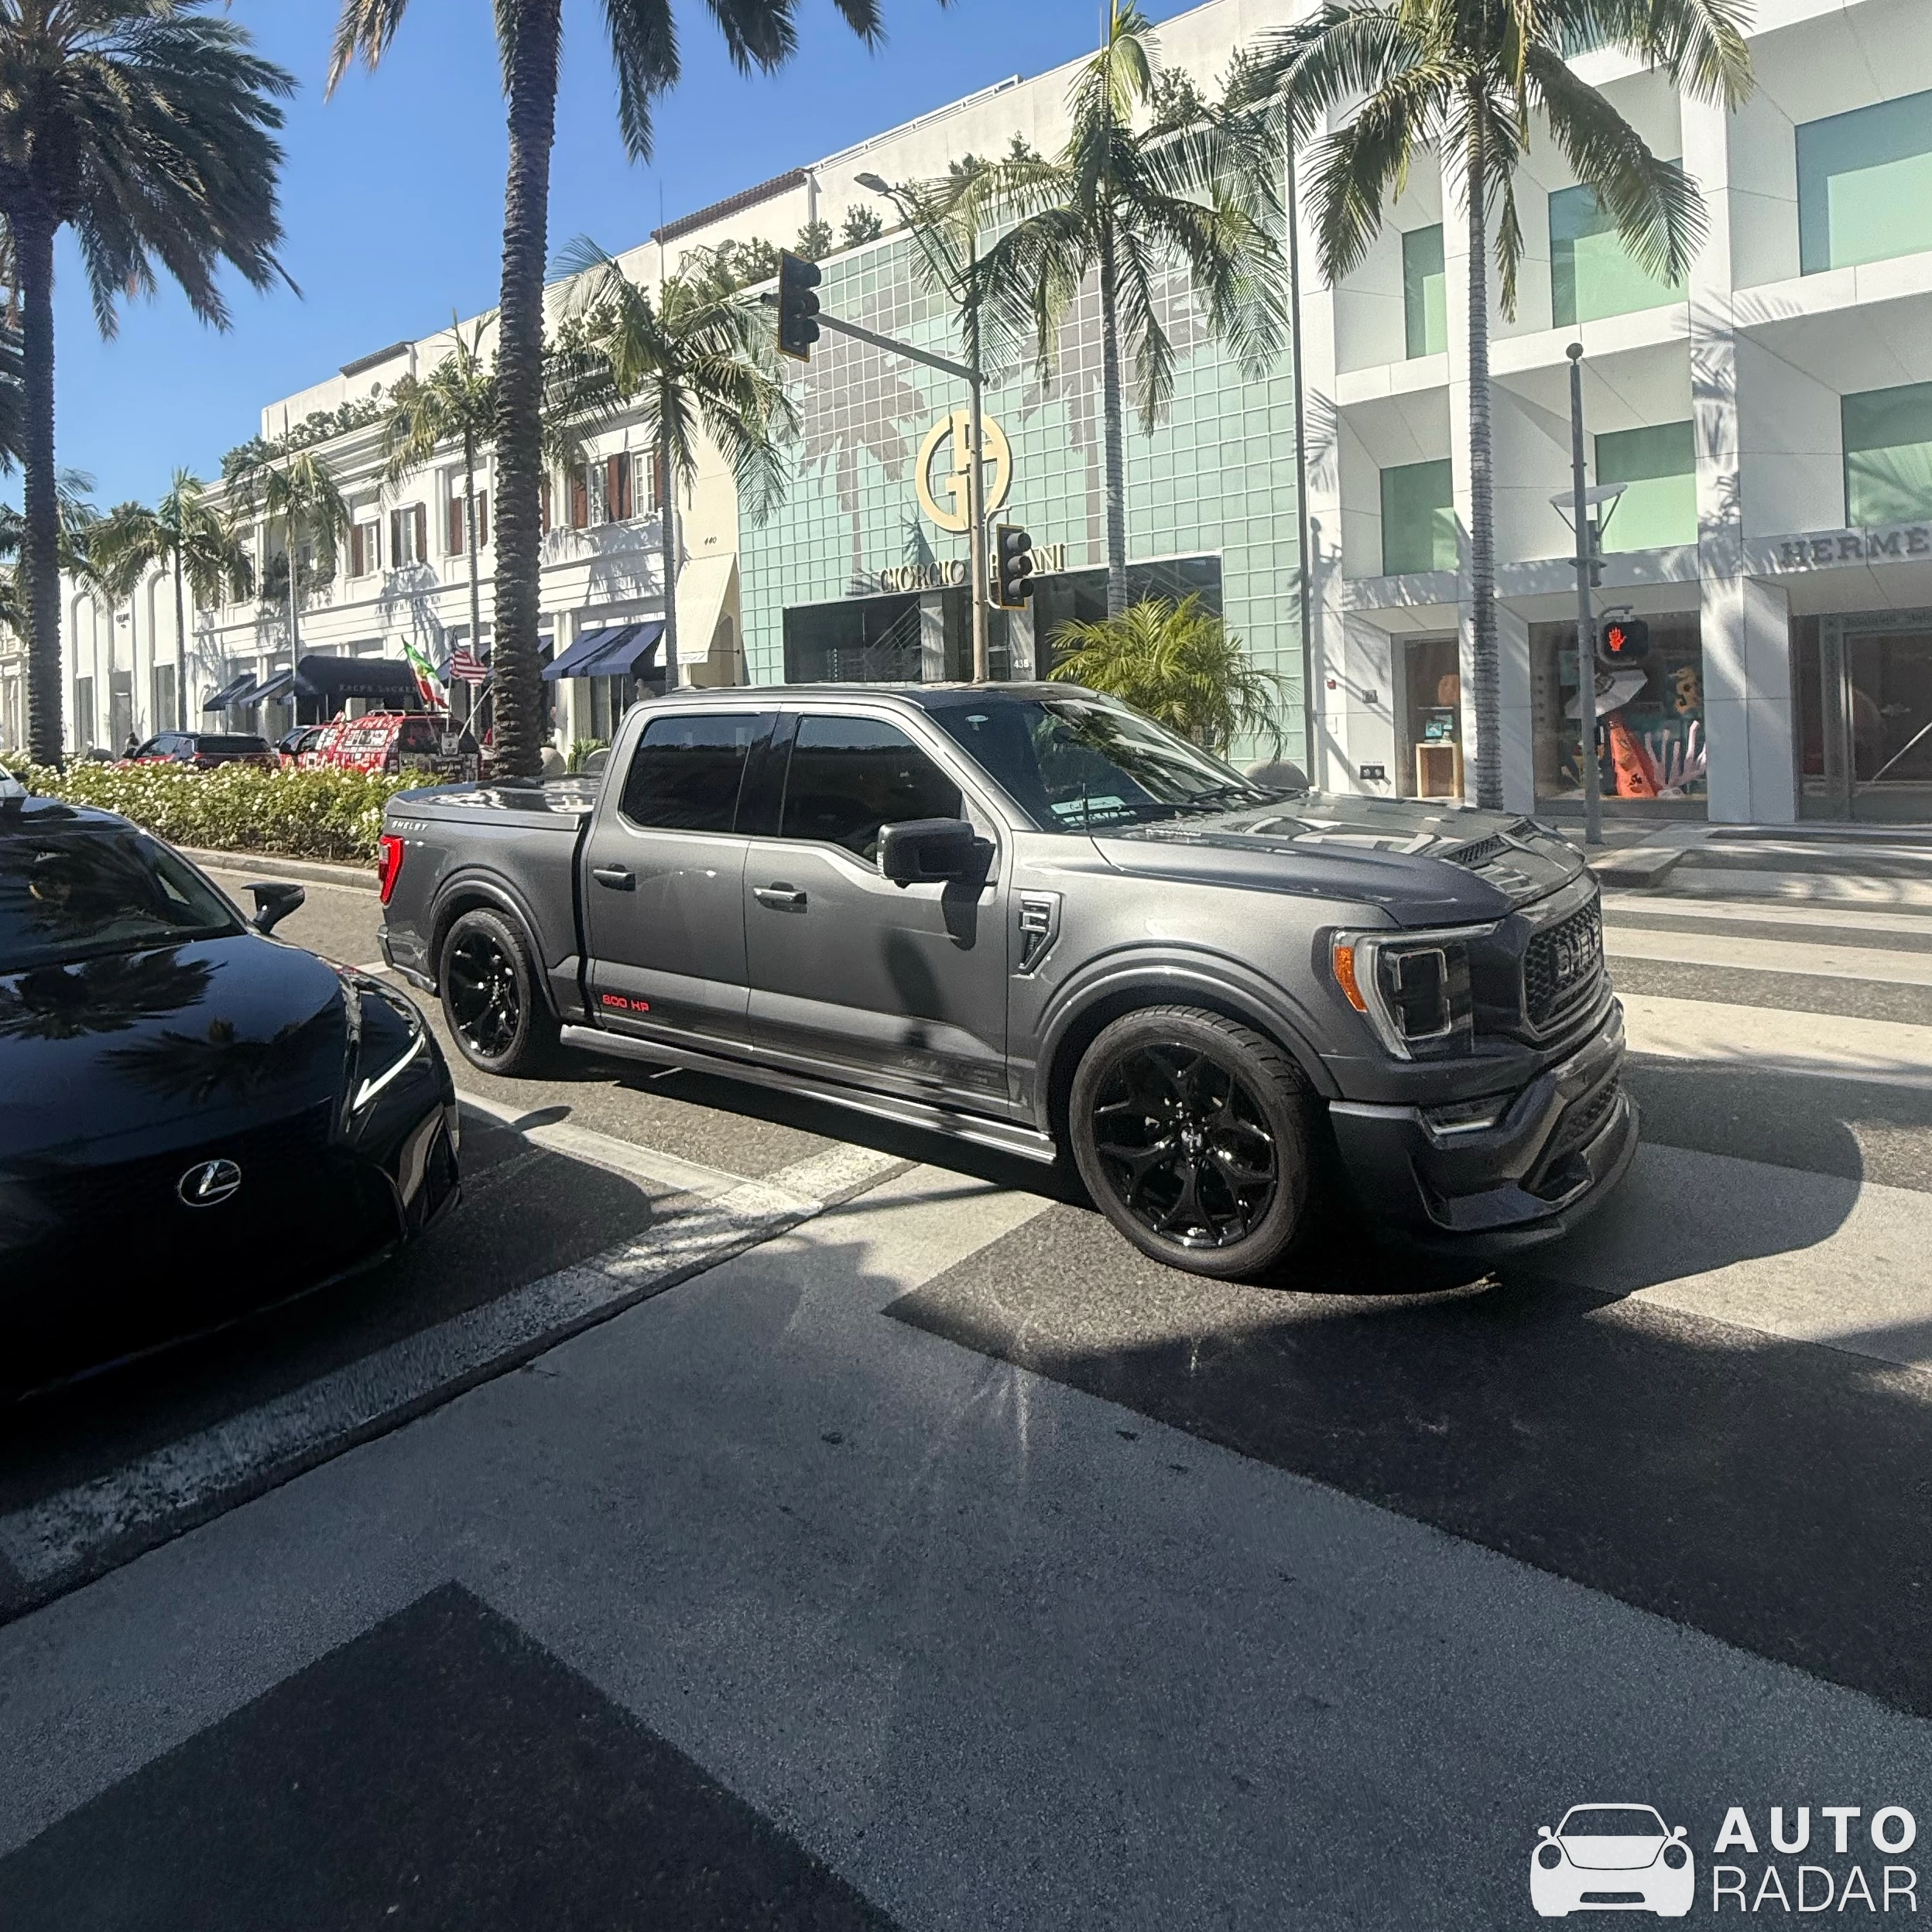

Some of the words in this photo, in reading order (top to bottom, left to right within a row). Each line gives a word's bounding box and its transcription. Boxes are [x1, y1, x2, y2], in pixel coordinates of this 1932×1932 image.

[880, 559, 966, 593] GIORGIO
[391, 820, 428, 831] SHELBY
[630, 999, 649, 1012] HP
